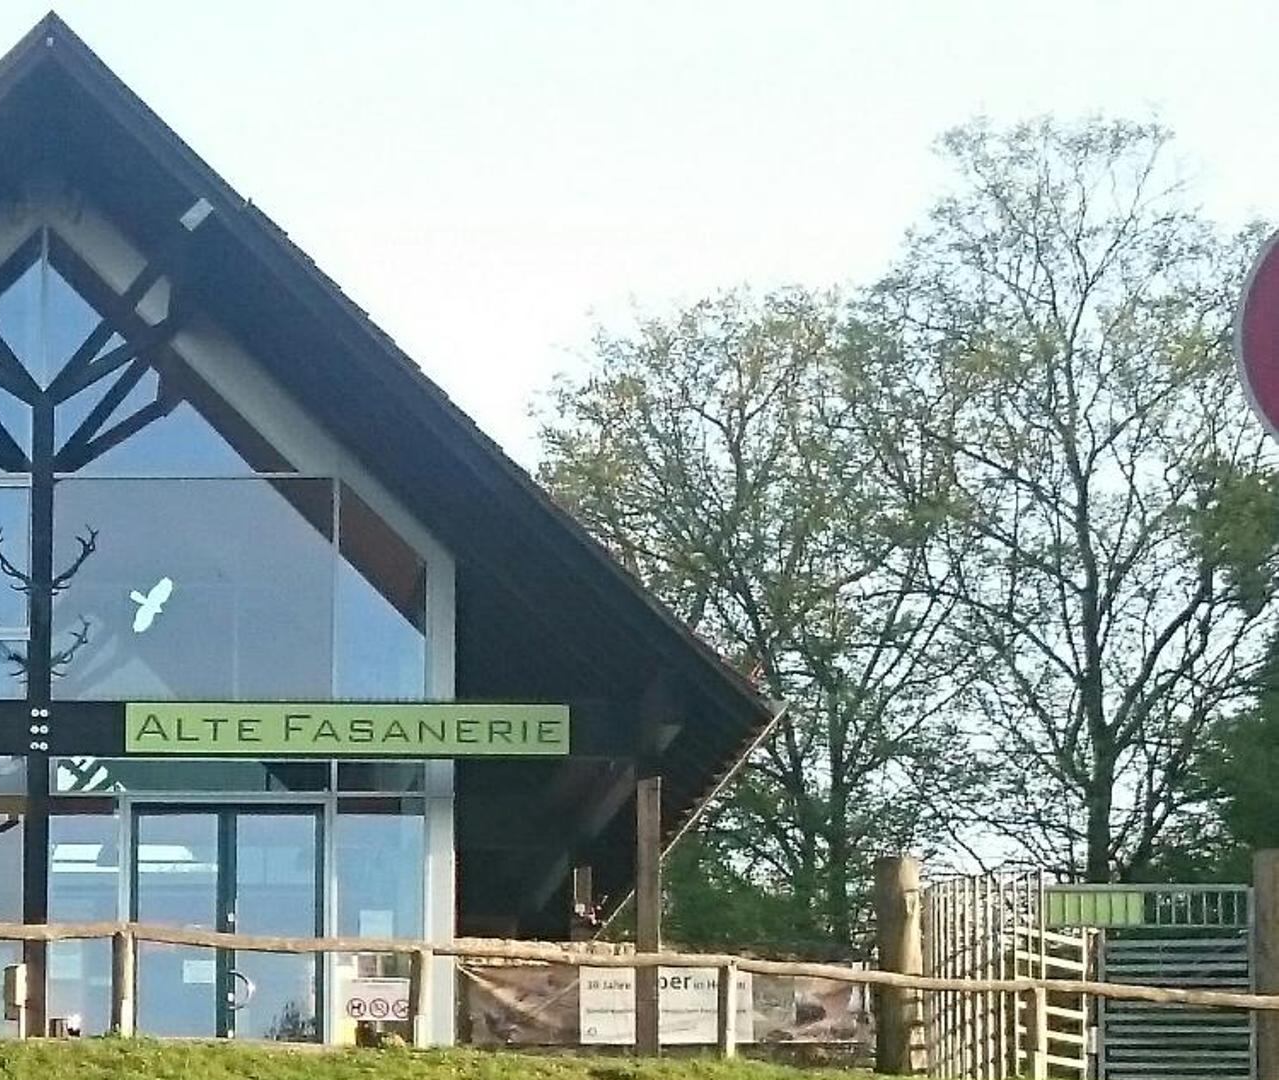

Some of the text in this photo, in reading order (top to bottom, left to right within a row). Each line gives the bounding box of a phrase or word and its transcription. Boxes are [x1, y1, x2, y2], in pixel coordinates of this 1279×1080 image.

[135, 714, 562, 743] ALTE FASANERIE
[659, 976, 692, 990] ber
